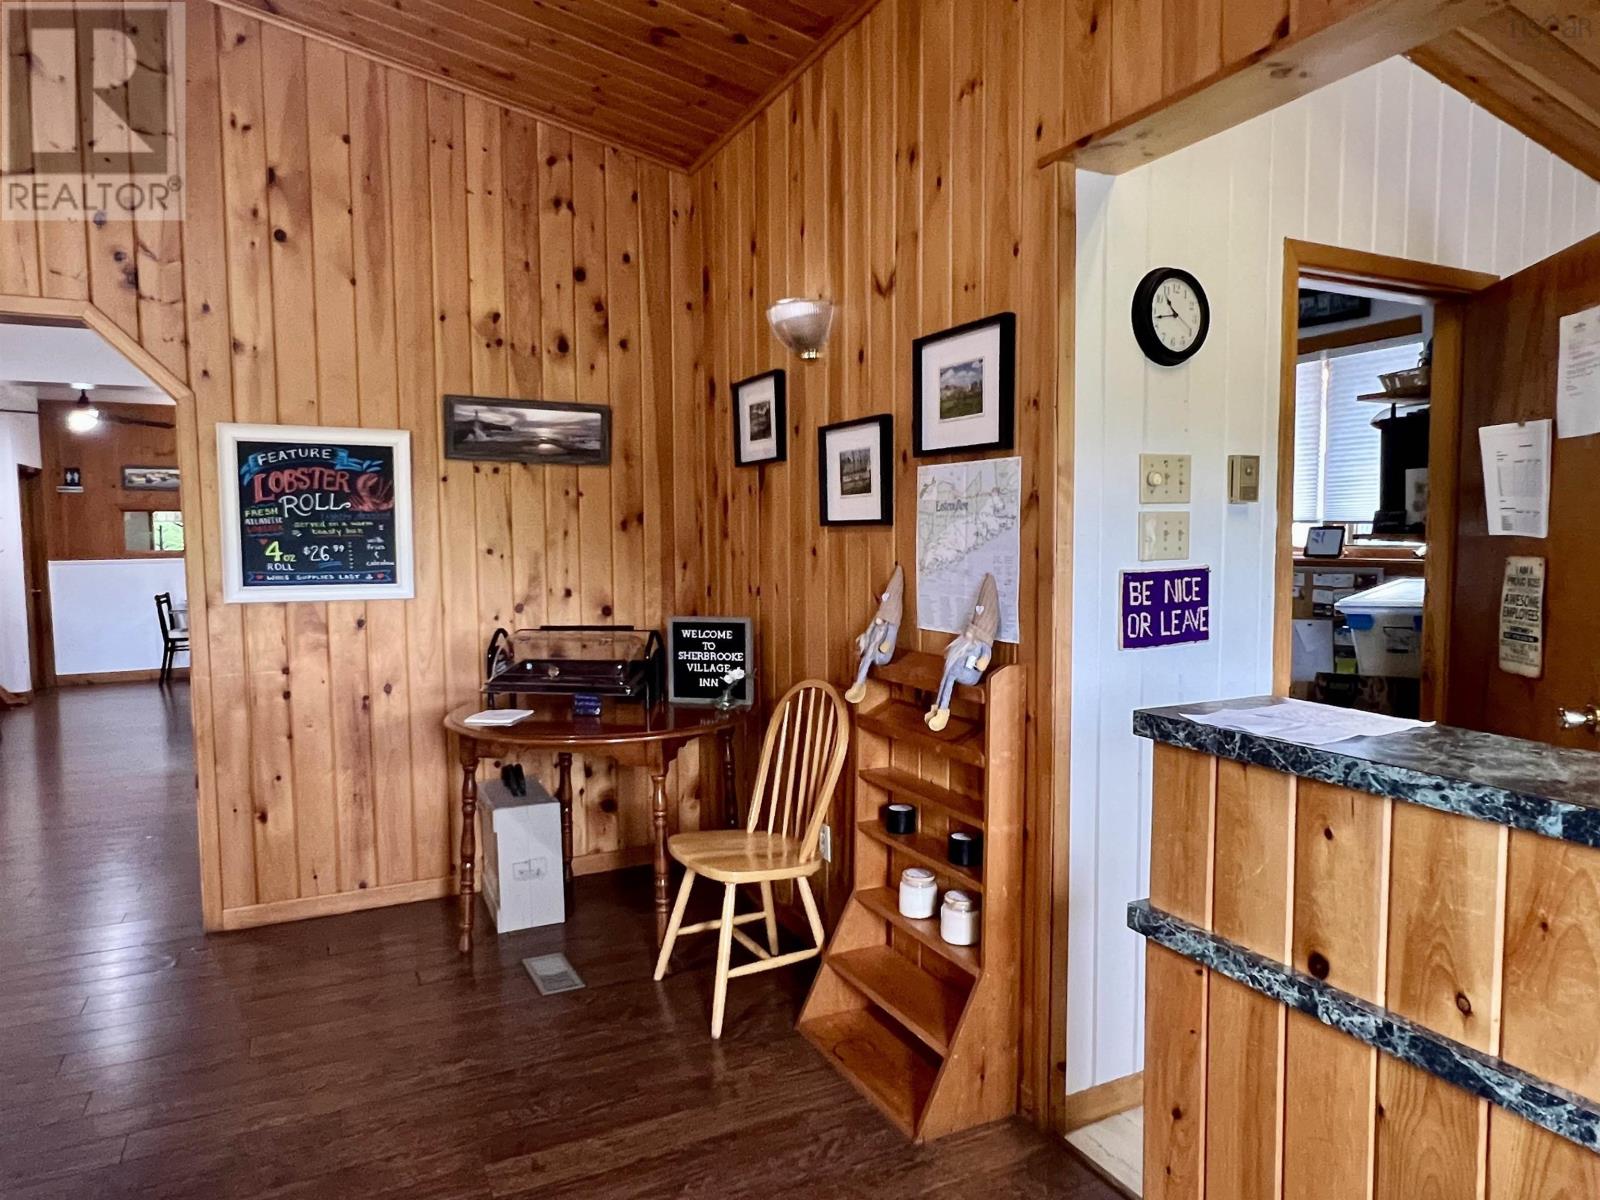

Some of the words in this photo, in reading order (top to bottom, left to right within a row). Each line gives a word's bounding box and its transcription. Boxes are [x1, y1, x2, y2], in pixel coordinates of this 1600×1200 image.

[257, 447, 333, 466] FEATURE
[253, 466, 351, 504] LOBSTER
[278, 492, 352, 518] ROLL
[244, 507, 279, 518] FRESH
[265, 541, 284, 562] 4
[267, 563, 295, 571] ROLL
[1128, 580, 1154, 606] BE
[1164, 576, 1202, 604] NICE
[1127, 611, 1154, 639] OR
[1160, 606, 1208, 636] LEAVE
[681, 629, 733, 640] WELCOME
[701, 641, 716, 651] TO
[677, 651, 744, 661] SHERBROOKE
[686, 663, 731, 673] VILLAGE
[699, 677, 719, 687] INN
